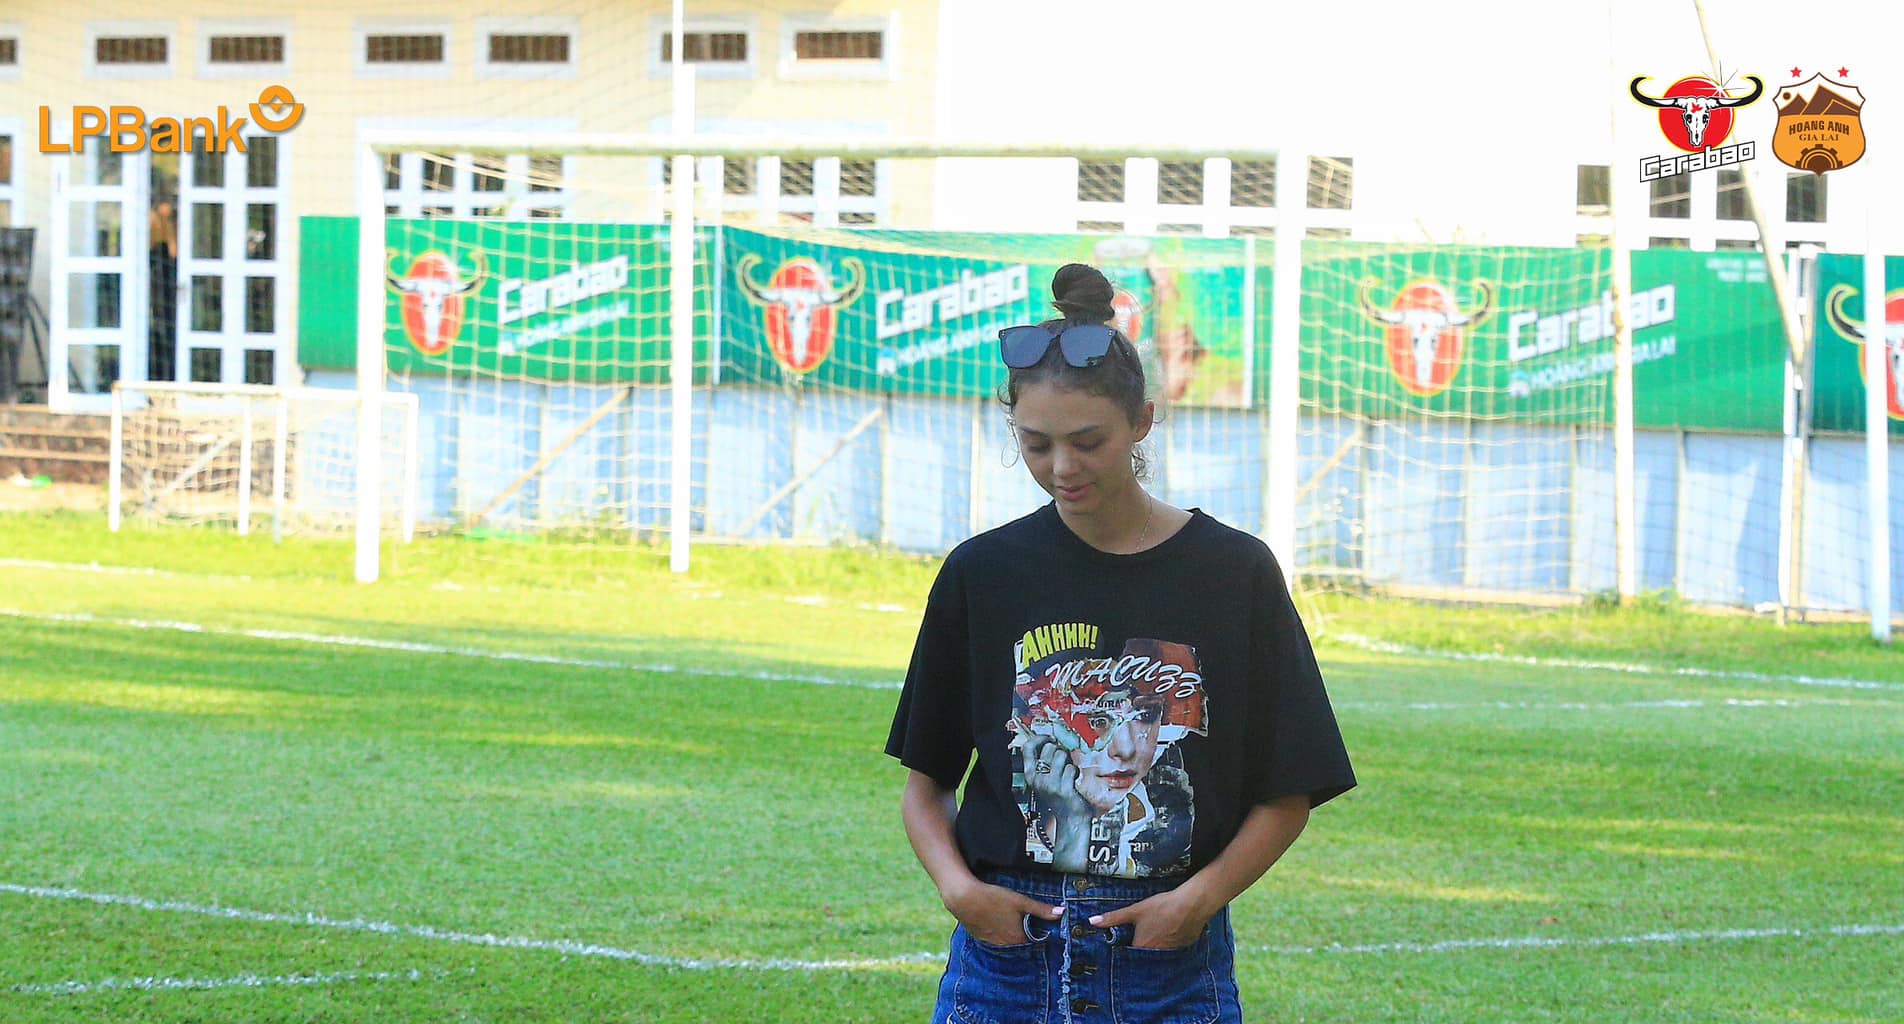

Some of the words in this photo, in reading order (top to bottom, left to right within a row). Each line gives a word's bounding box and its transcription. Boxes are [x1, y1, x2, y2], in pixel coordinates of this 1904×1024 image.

[498, 255, 629, 325] Carabao
[876, 264, 1029, 340] Carabao
[1022, 622, 1099, 670] AHHHH!
